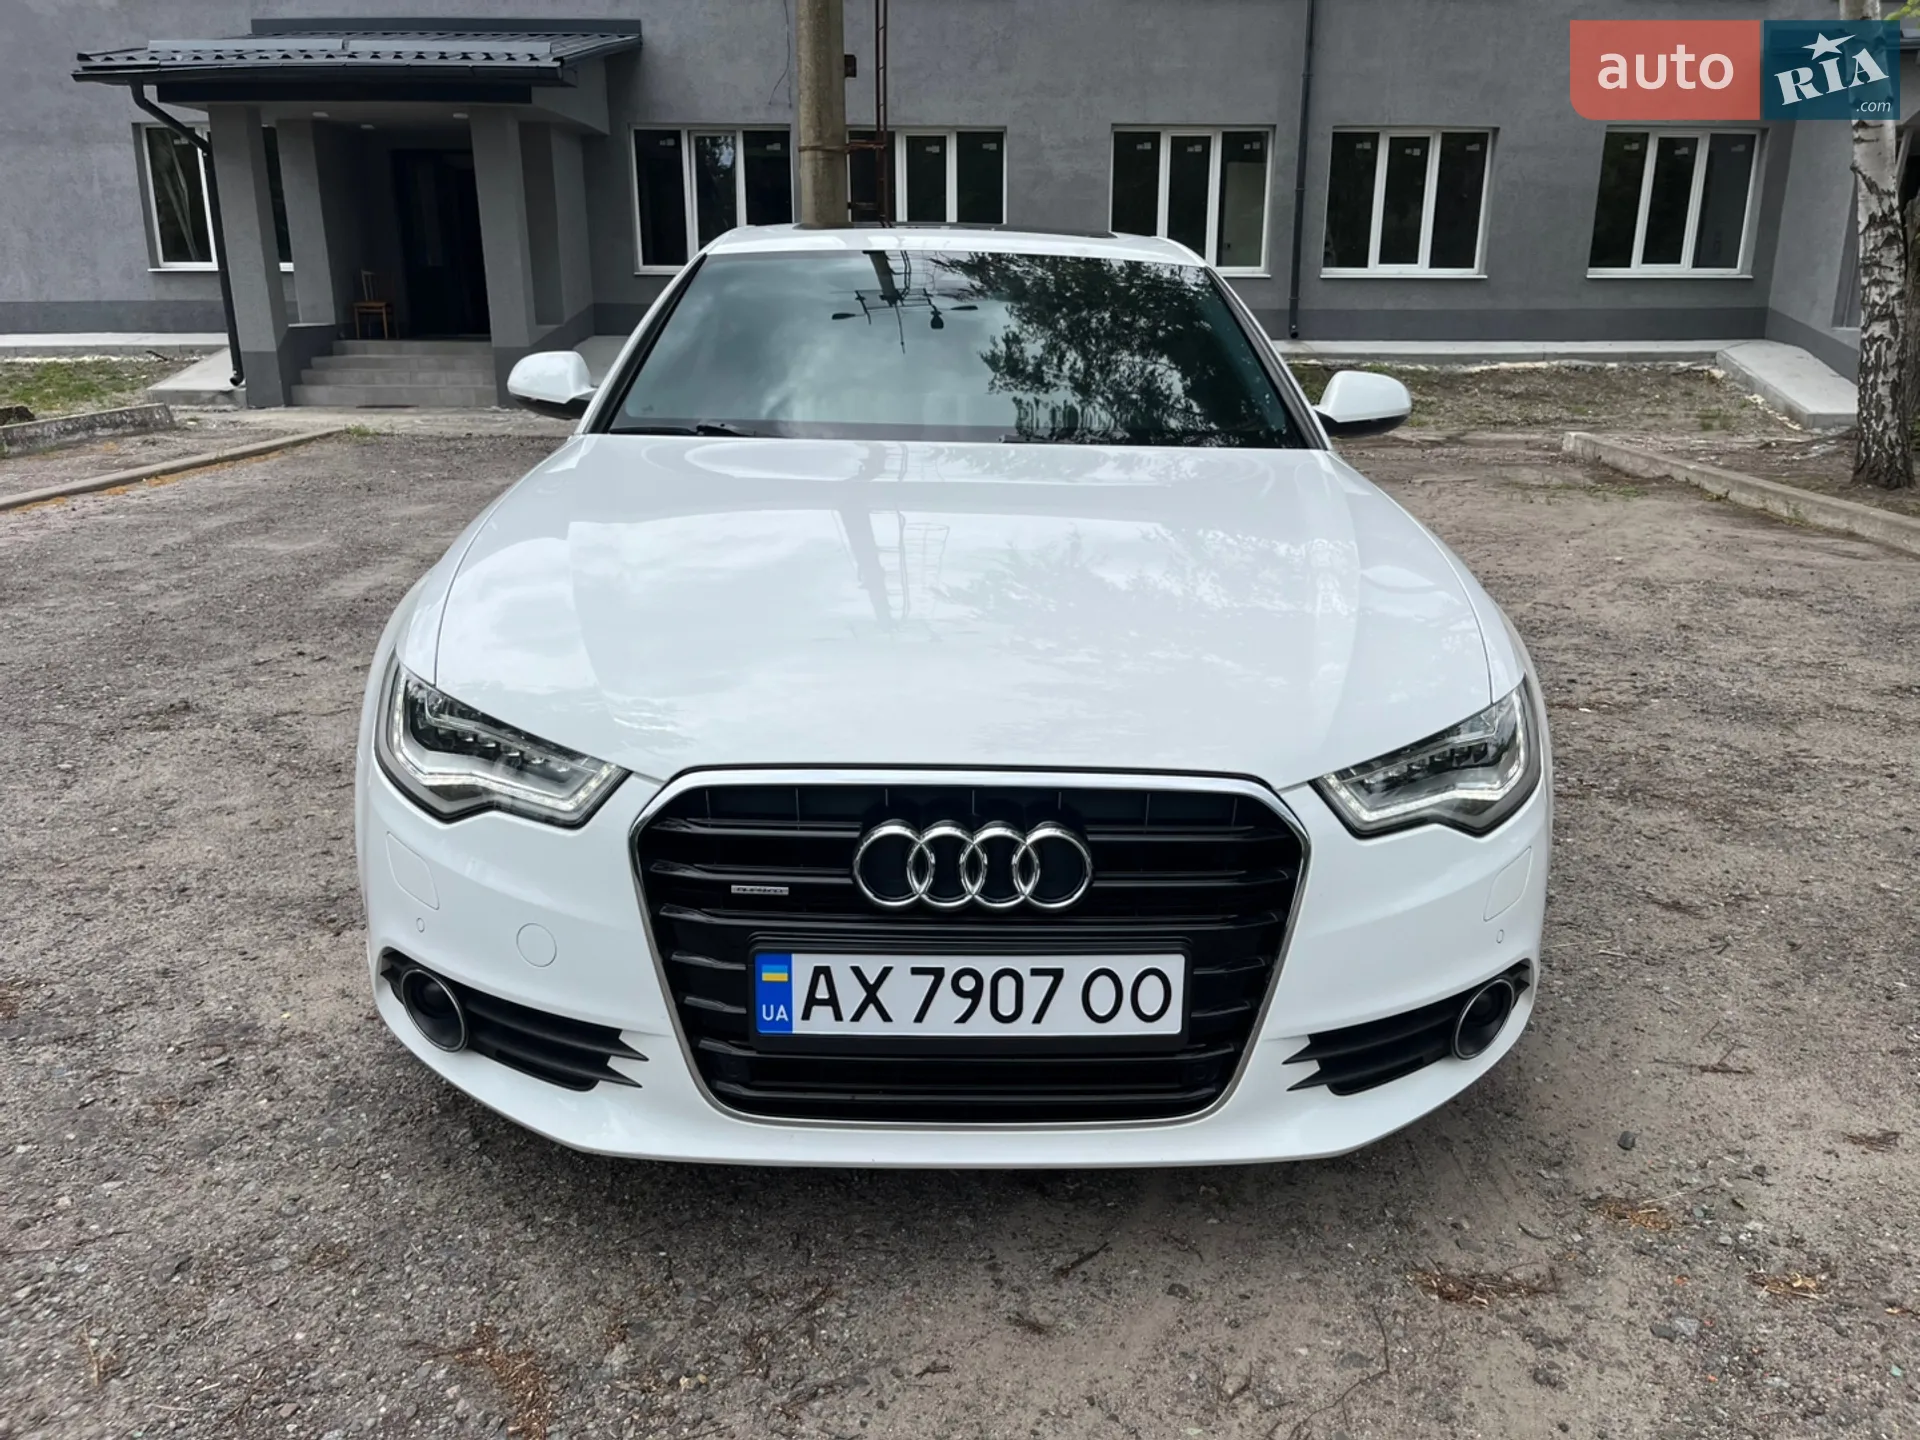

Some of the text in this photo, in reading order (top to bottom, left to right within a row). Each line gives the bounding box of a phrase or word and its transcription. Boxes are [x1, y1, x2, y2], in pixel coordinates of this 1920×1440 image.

[762, 1004, 789, 1022] UA
[801, 965, 894, 1023] AX
[910, 966, 1065, 1024] 7907
